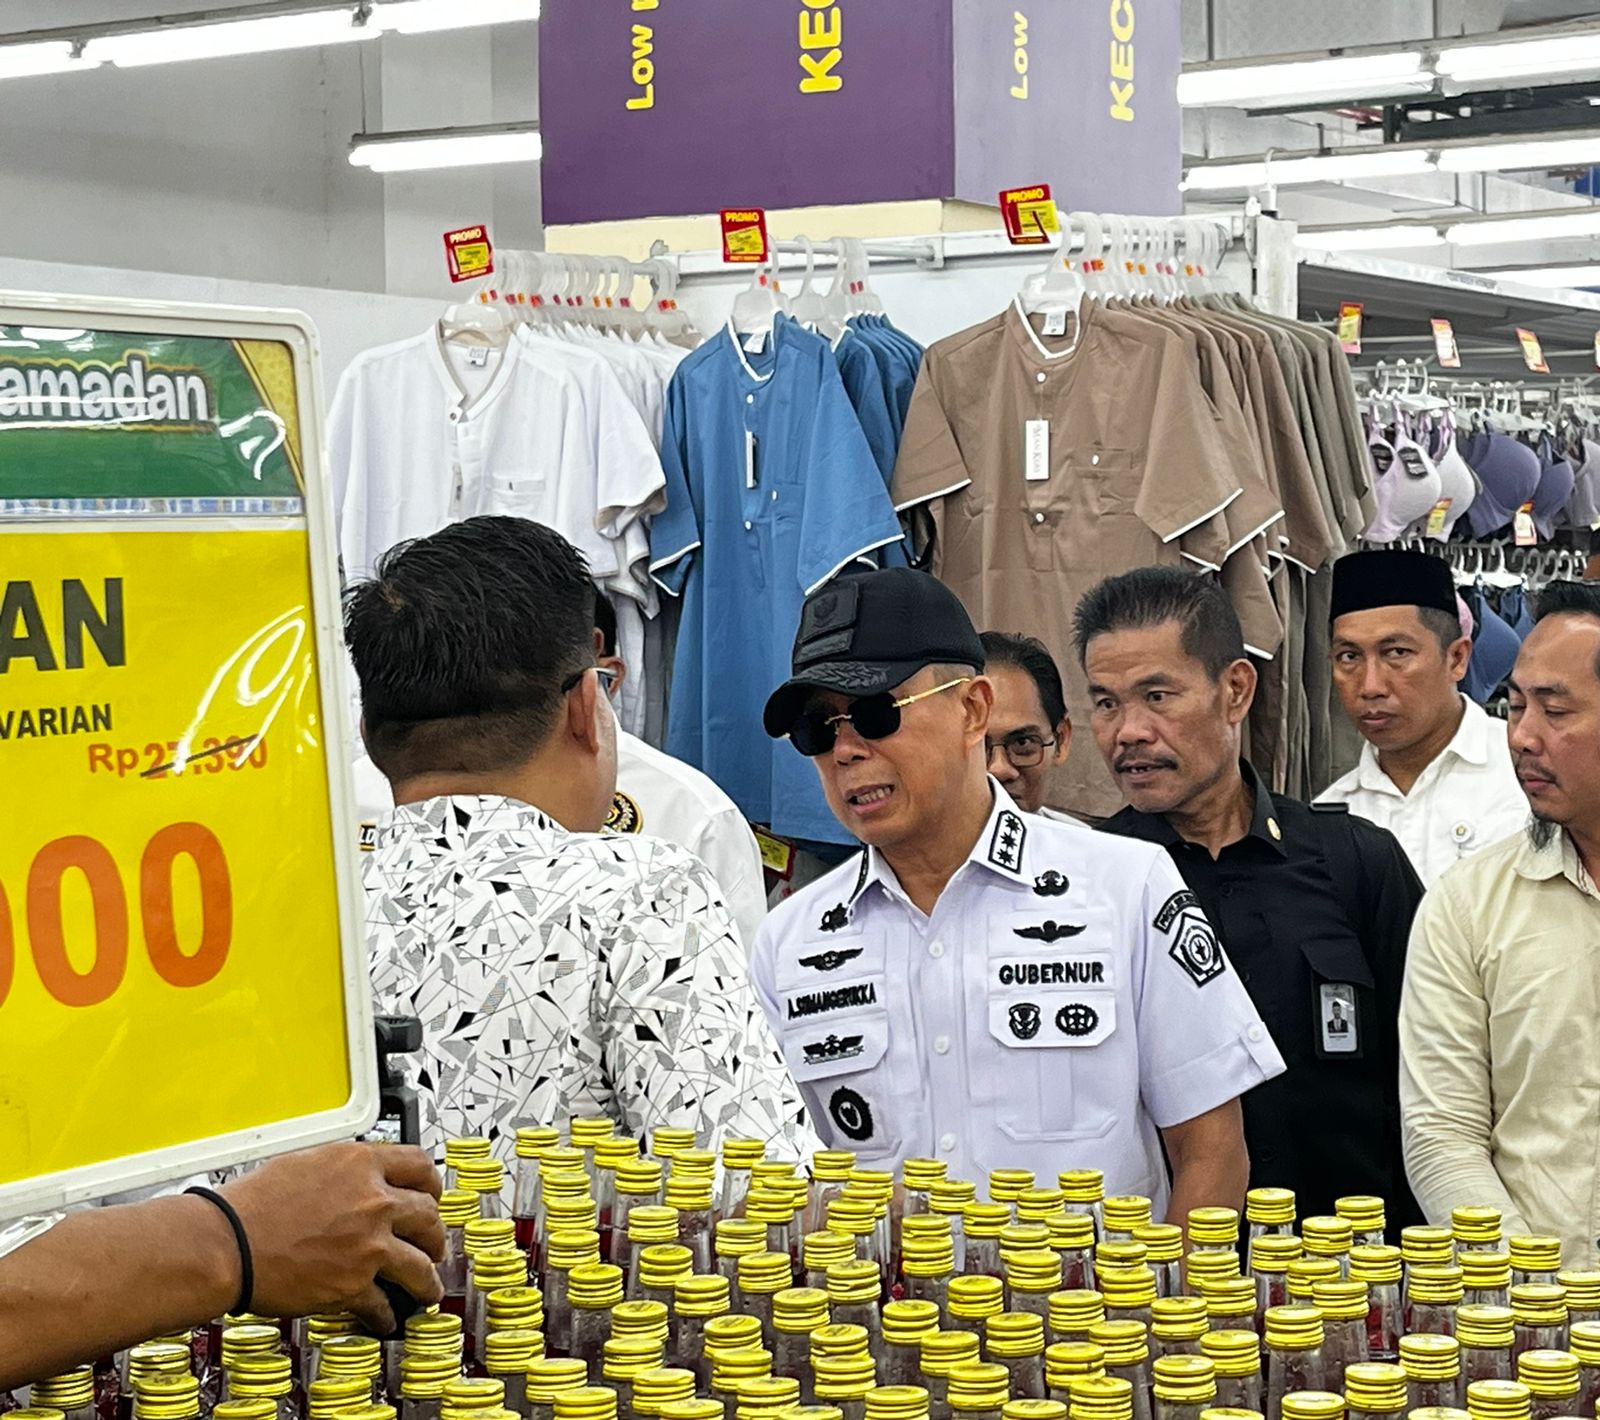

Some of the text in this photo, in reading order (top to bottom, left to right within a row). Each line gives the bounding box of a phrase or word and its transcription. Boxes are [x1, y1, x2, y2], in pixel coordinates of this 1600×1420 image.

[799, 0, 843, 94] KE
[1006, 187, 1045, 204] PROMO
[725, 211, 760, 223] PROMO
[0, 577, 126, 674] AN
[0, 703, 112, 740] VARIAN
[0, 821, 233, 1009] 00
[999, 962, 1105, 985] GUBERNUR
